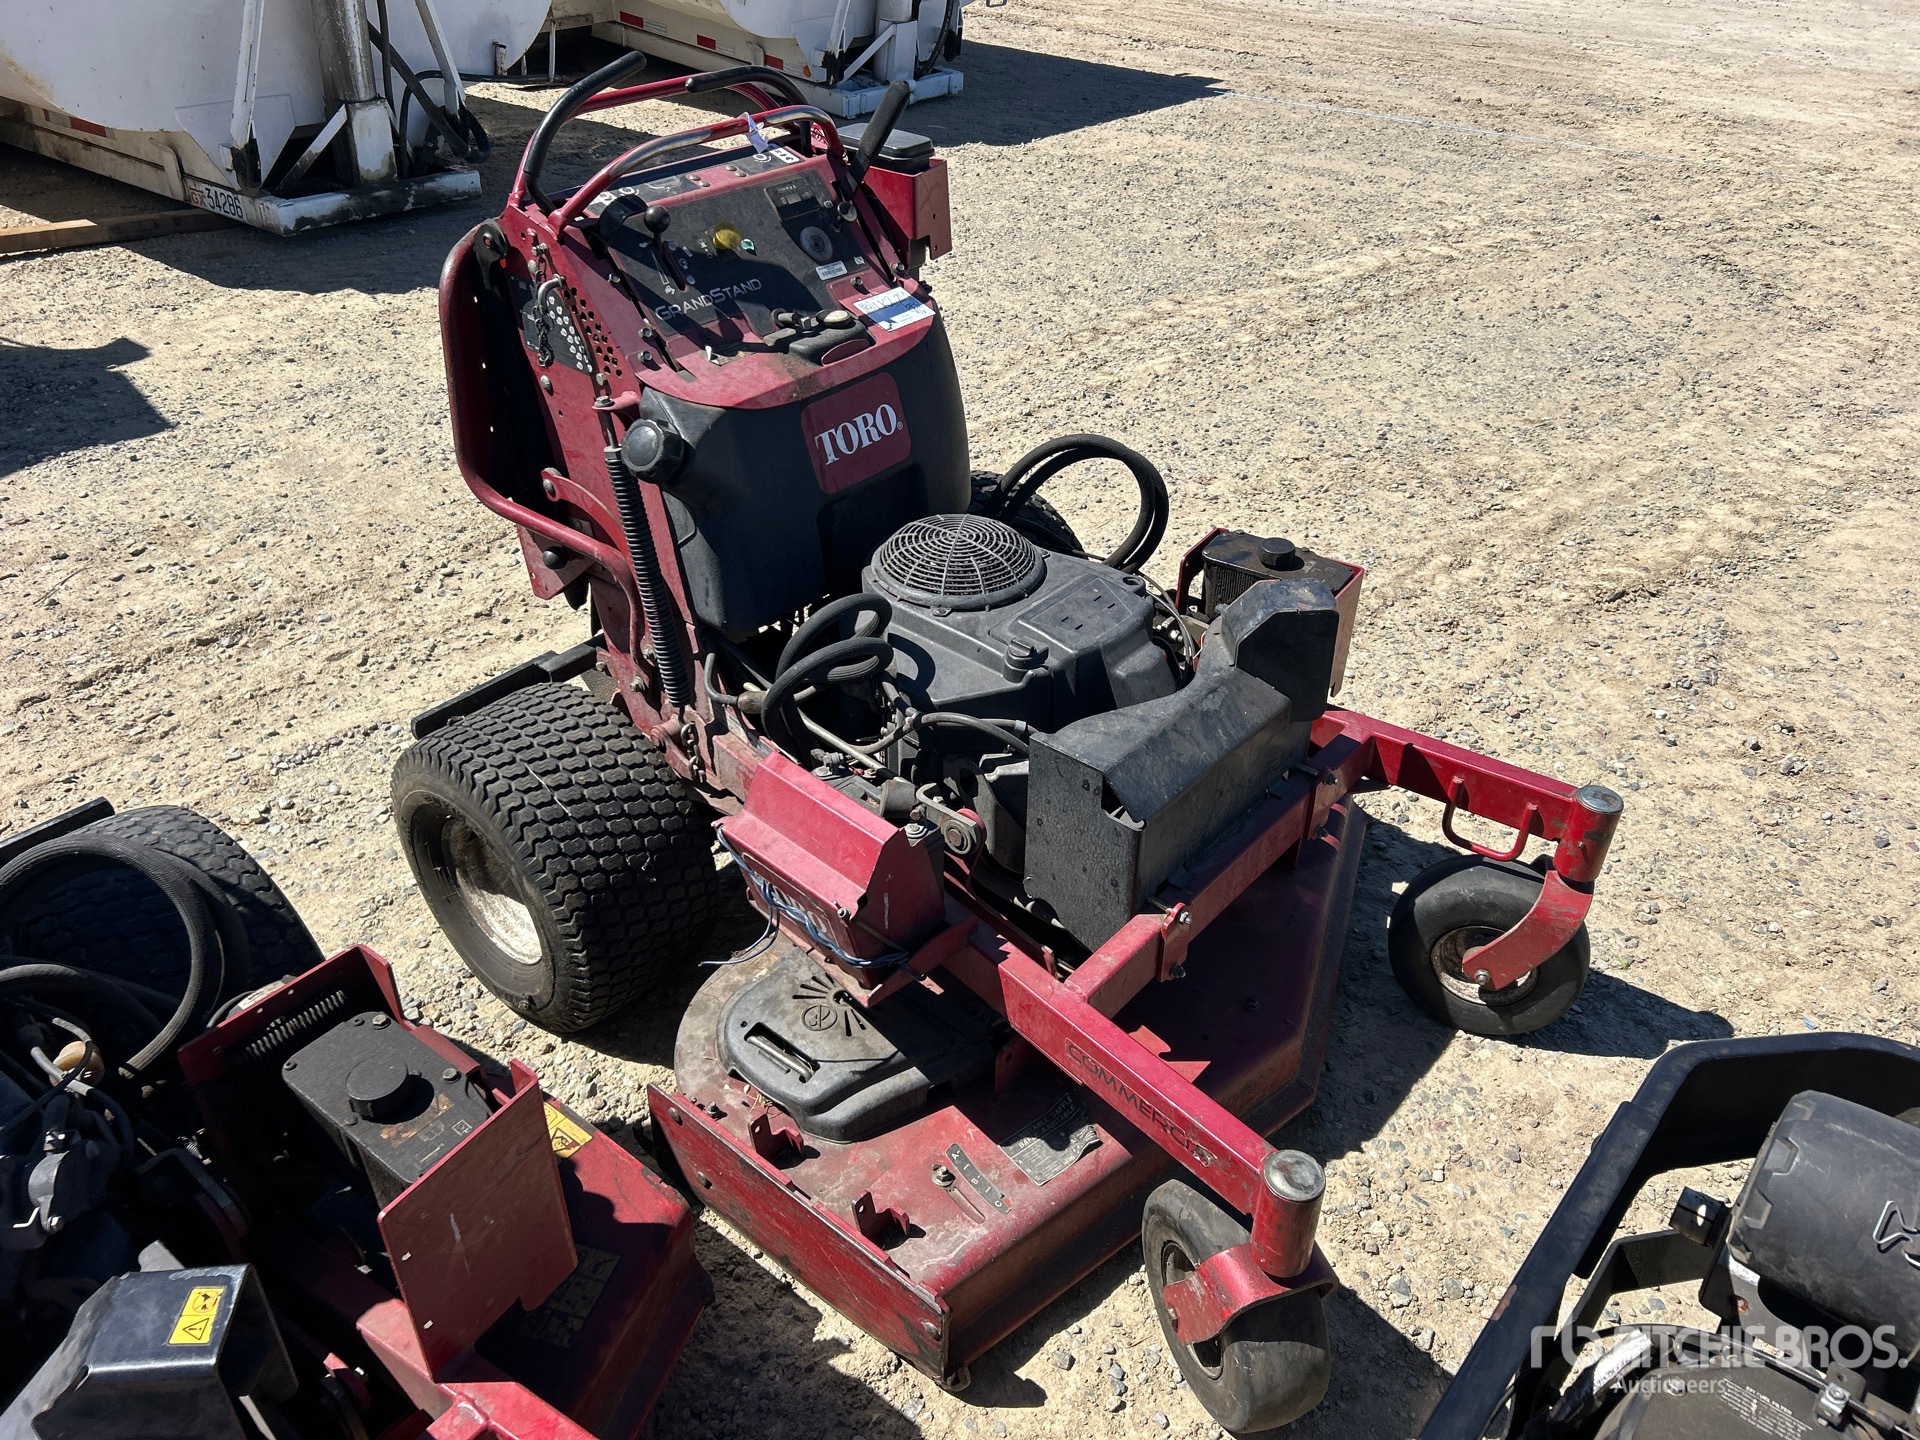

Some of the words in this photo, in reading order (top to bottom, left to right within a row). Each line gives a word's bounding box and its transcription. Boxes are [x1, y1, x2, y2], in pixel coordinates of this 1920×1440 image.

[204, 187, 244, 219] 34286
[814, 403, 897, 465] TORO
[1067, 1043, 1210, 1168] COMMERCI
